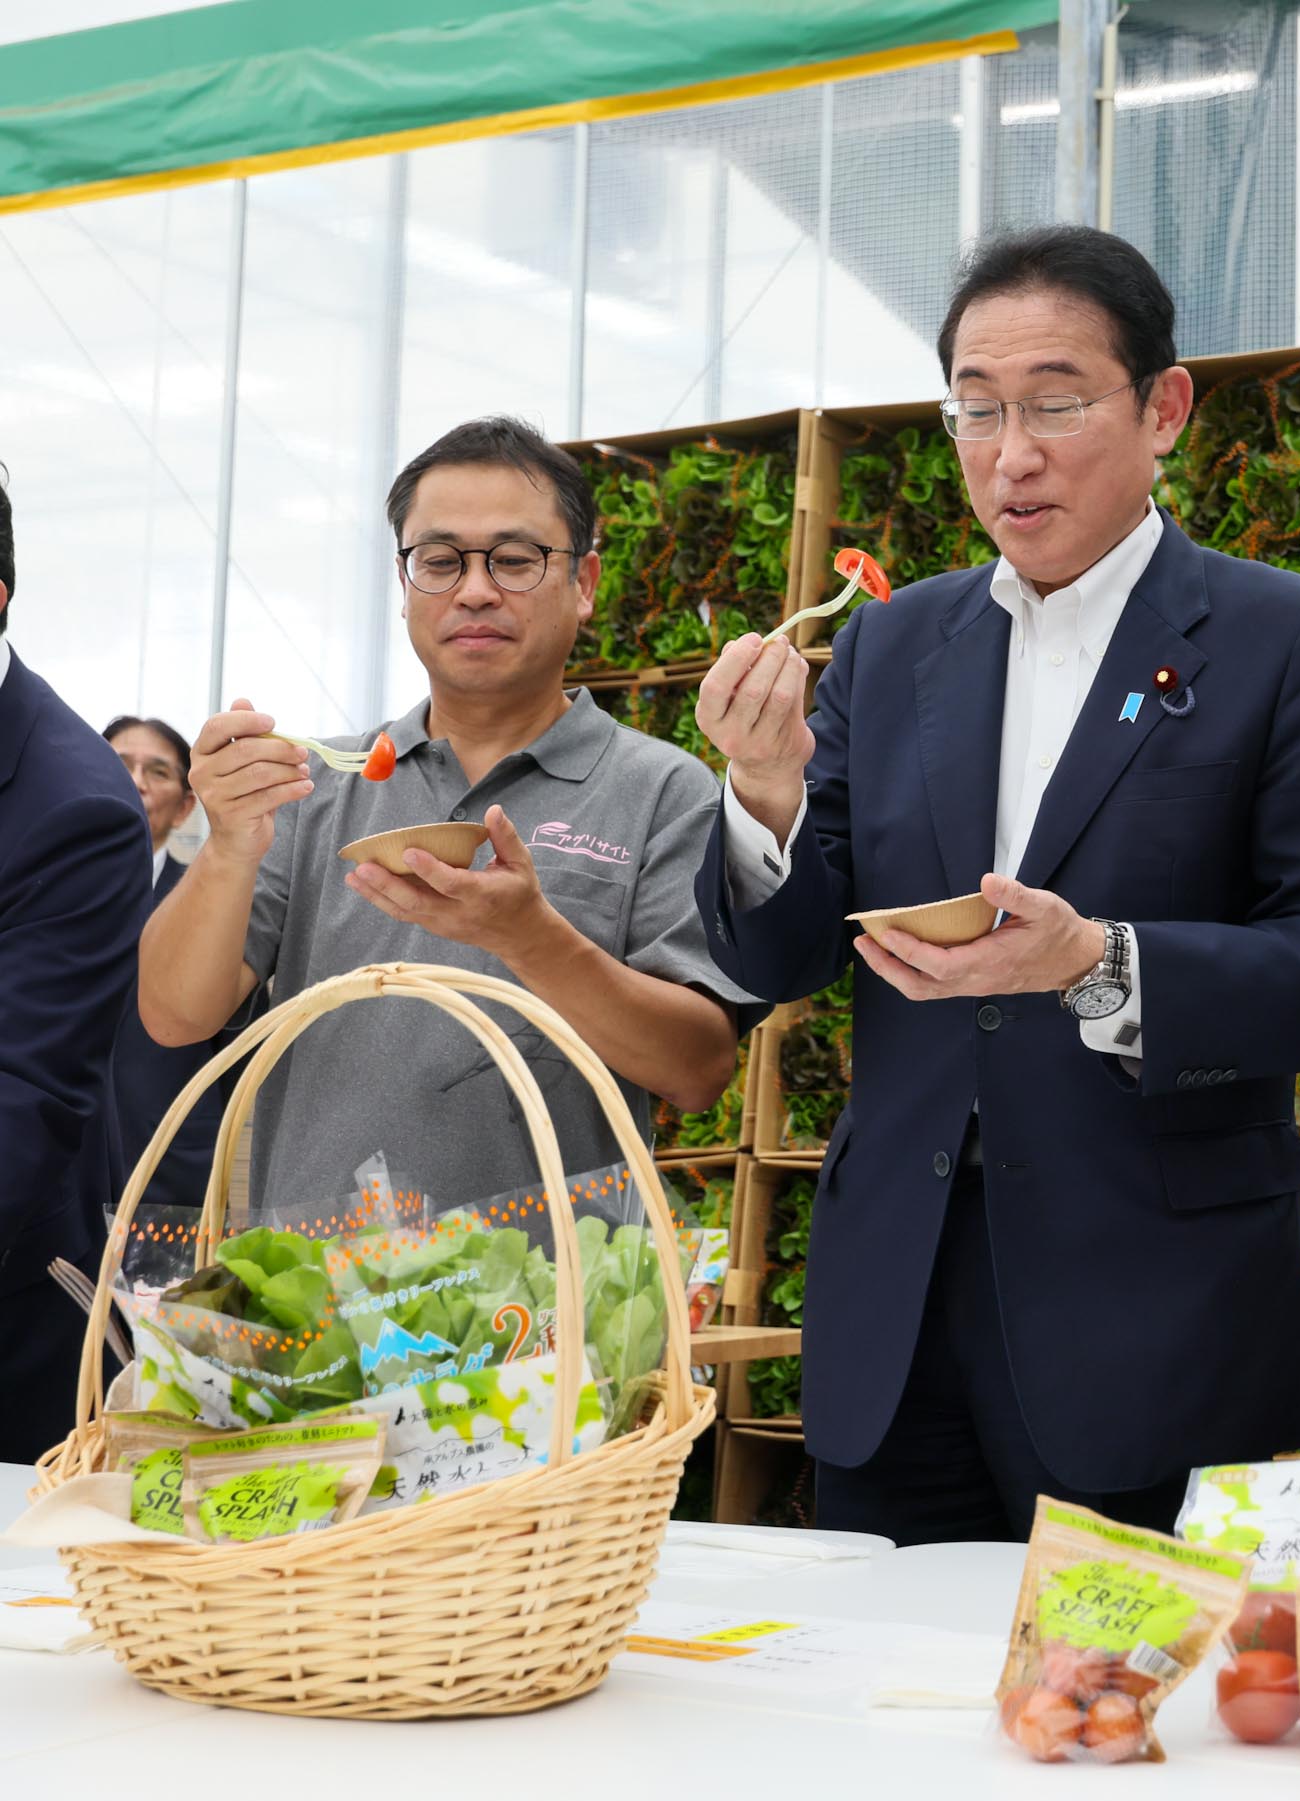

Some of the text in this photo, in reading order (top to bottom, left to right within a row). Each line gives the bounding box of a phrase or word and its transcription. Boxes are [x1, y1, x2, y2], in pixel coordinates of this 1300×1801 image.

[557, 832, 631, 860] アグリサイト
[230, 1477, 303, 1504] CRAFT
[1075, 1584, 1156, 1617] CRAFT
[1052, 1598, 1144, 1635] SPLASH
